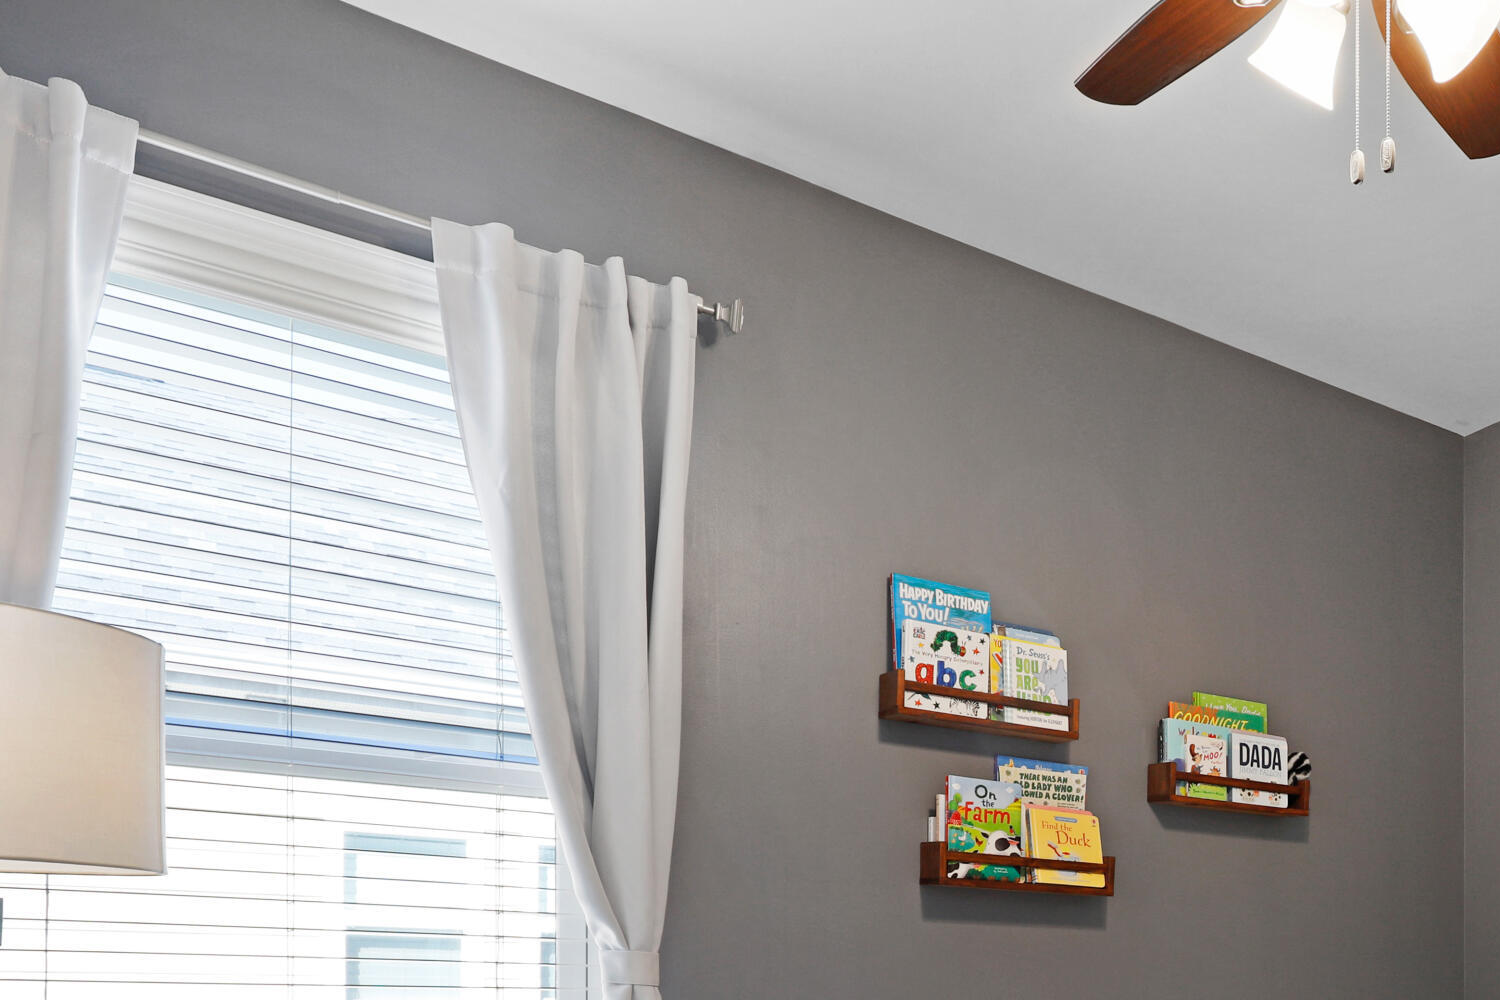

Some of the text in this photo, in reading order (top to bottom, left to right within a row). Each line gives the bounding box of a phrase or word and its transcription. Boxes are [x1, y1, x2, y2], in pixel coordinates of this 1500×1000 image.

[899, 582, 989, 614] HAPPY BIRTHDAY
[1016, 646, 1050, 661] Dr. Seuss's
[1016, 657, 1039, 674] YOU
[1174, 711, 1248, 731] GOODNIGHT
[1240, 742, 1282, 771] DADA
[1019, 773, 1040, 781] THERE
[974, 784, 997, 800] On
[1031, 783, 1052, 791] LADY
[1054, 784, 1073, 793] WHO
[1052, 793, 1084, 803] CLOVER!
[964, 801, 1011, 825] Farm
[1041, 820, 1073, 832] Find the
[1055, 830, 1092, 848] Duck
